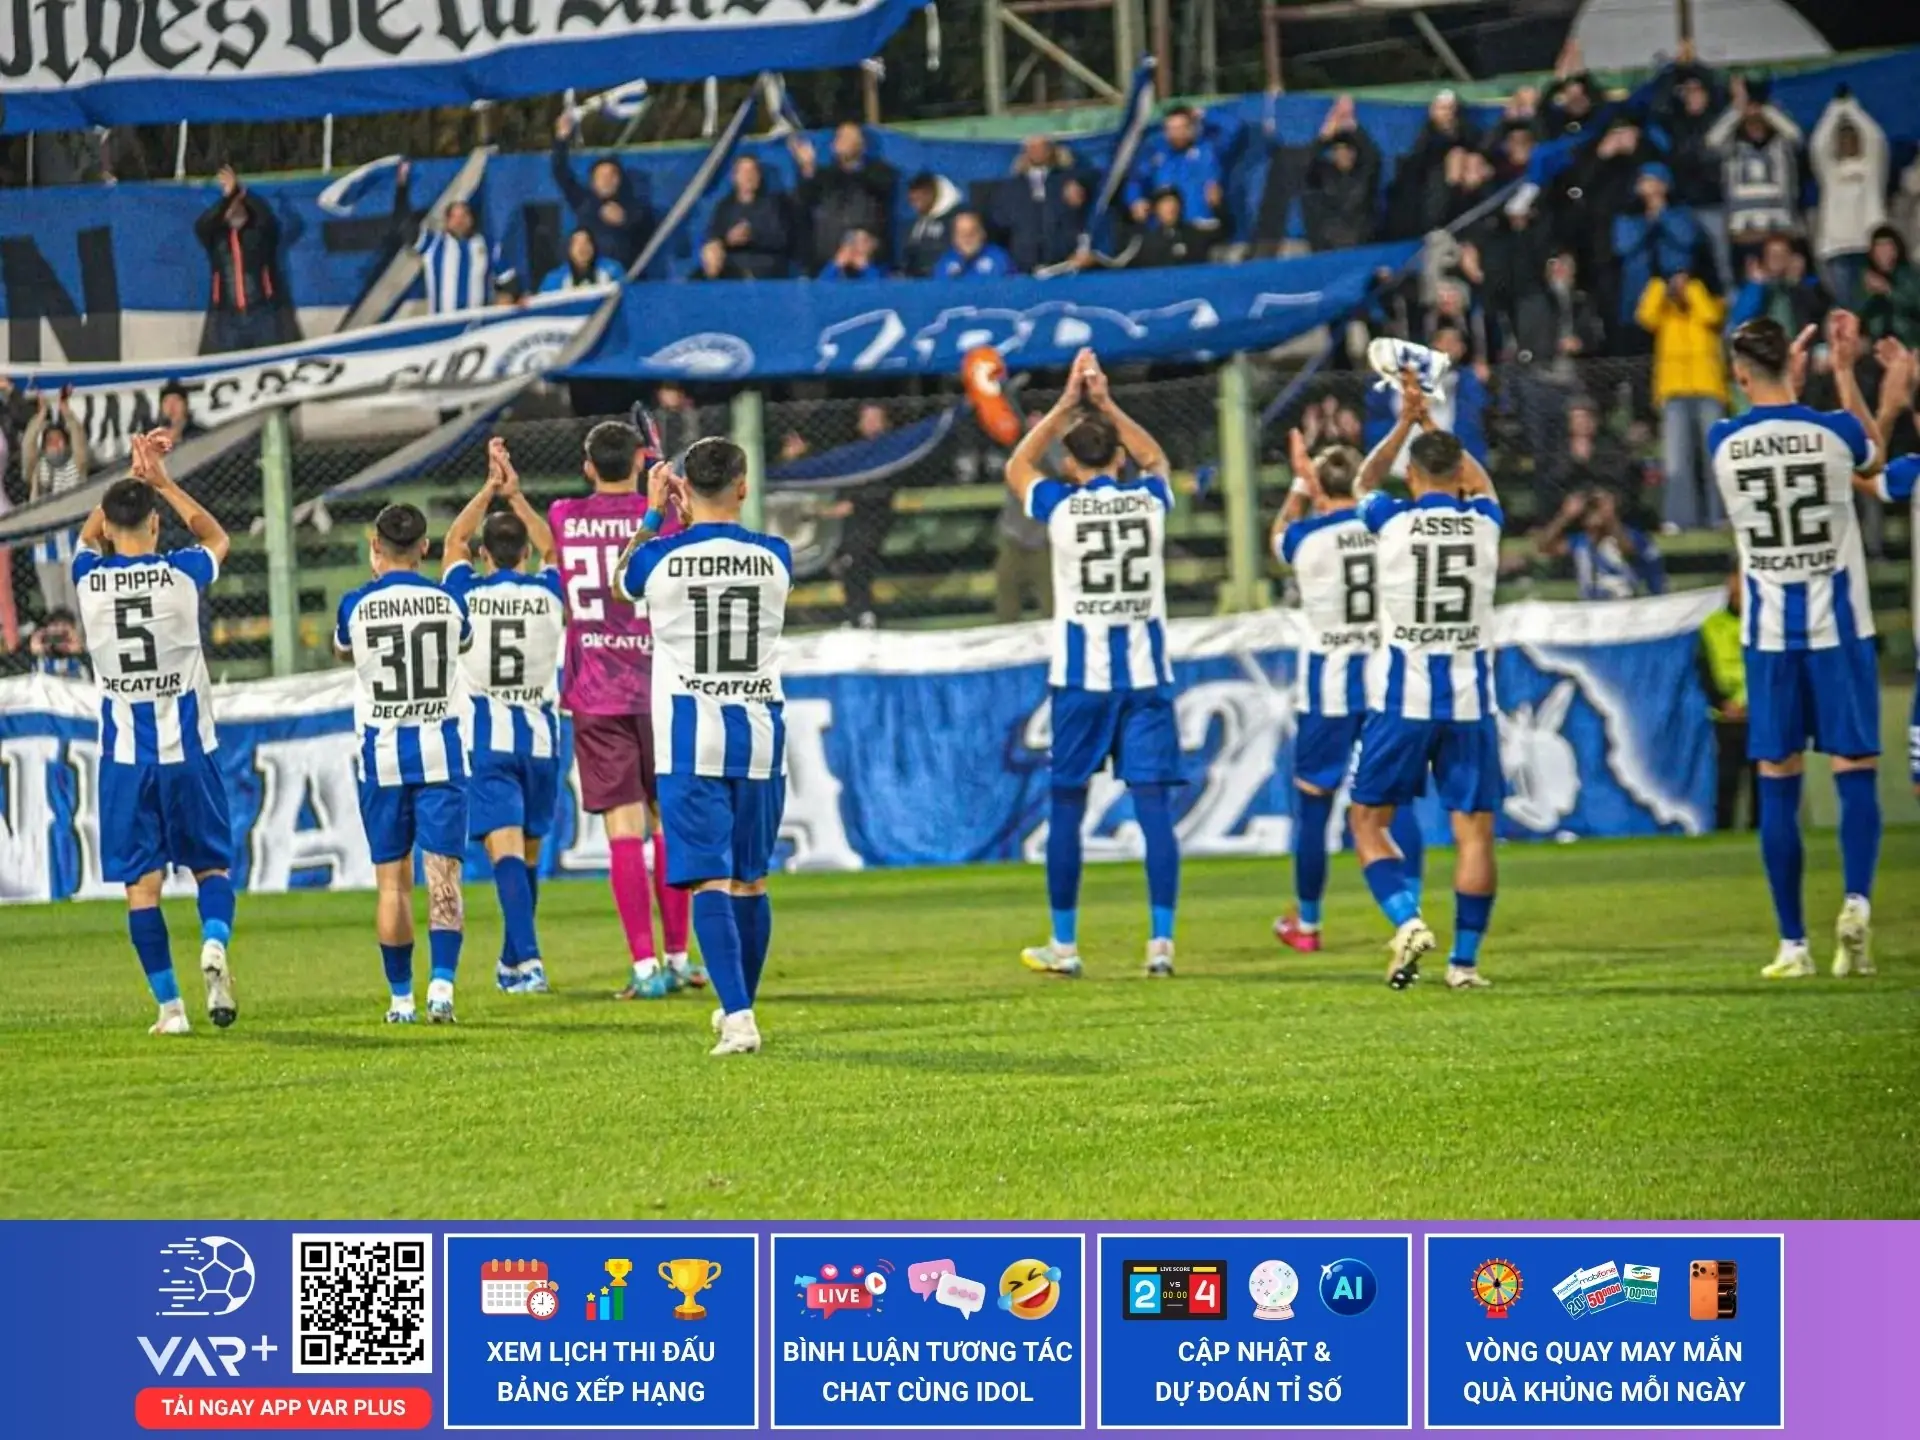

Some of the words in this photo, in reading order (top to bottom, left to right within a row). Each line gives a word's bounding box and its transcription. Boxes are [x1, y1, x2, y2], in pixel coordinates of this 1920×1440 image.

[1729, 433, 1825, 460] GIANOLI
[1736, 463, 1830, 547] 32
[564, 518, 643, 538] SANTIL
[1410, 516, 1475, 536] ASSIS
[668, 556, 775, 577] OTORMIN
[1076, 518, 1152, 593] 22
[90, 573, 106, 592] DI
[115, 568, 174, 591] PIPPA
[1343, 553, 1377, 623] 8
[1411, 544, 1475, 623] 15
[359, 596, 453, 620] HERNANDEZ
[115, 597, 158, 673] 5
[688, 586, 760, 674] 10
[1394, 625, 1481, 644] DECATUR
[491, 620, 526, 686] 6
[581, 633, 654, 655] DECATU
[366, 621, 448, 701] 30
[372, 701, 448, 719] DECATUR
